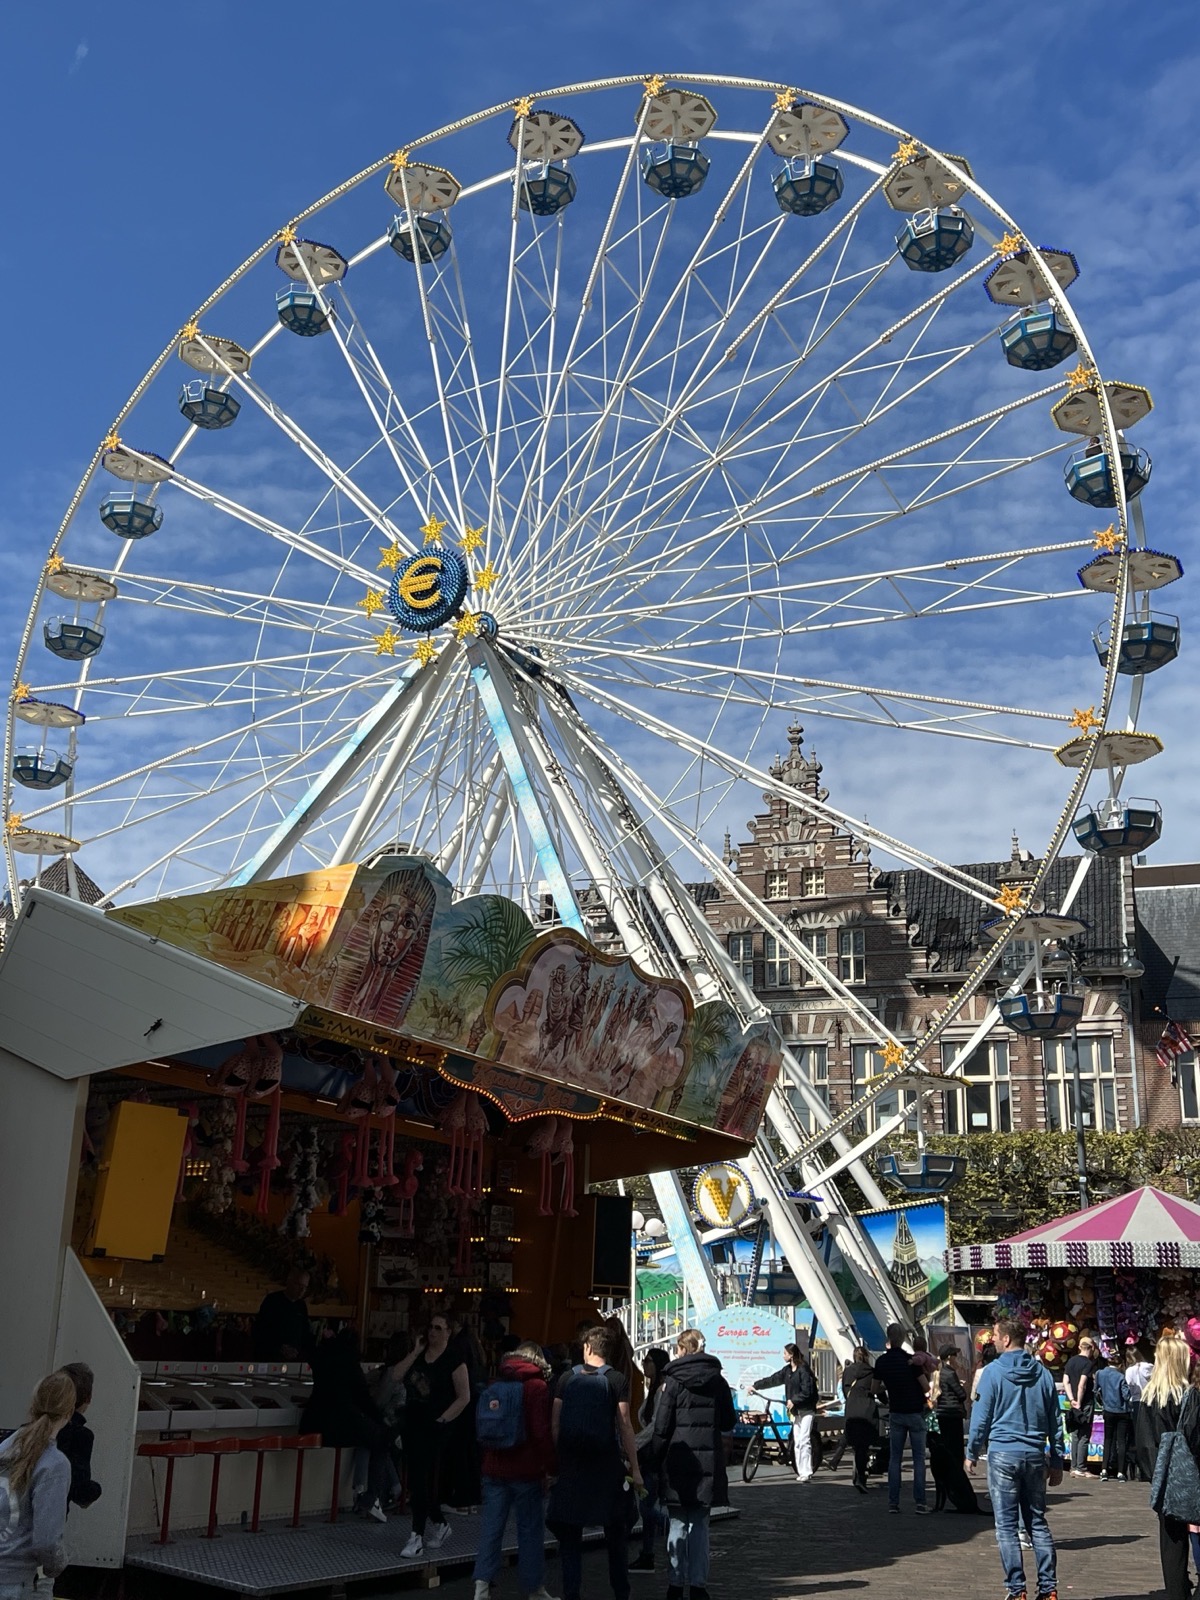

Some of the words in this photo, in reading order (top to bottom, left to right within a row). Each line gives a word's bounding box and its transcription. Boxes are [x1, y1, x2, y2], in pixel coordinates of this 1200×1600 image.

[538, 1083, 577, 1109] Race
[703, 1177, 742, 1221] V
[718, 1326, 748, 1338] Europa
[752, 1326, 771, 1336] Rad
